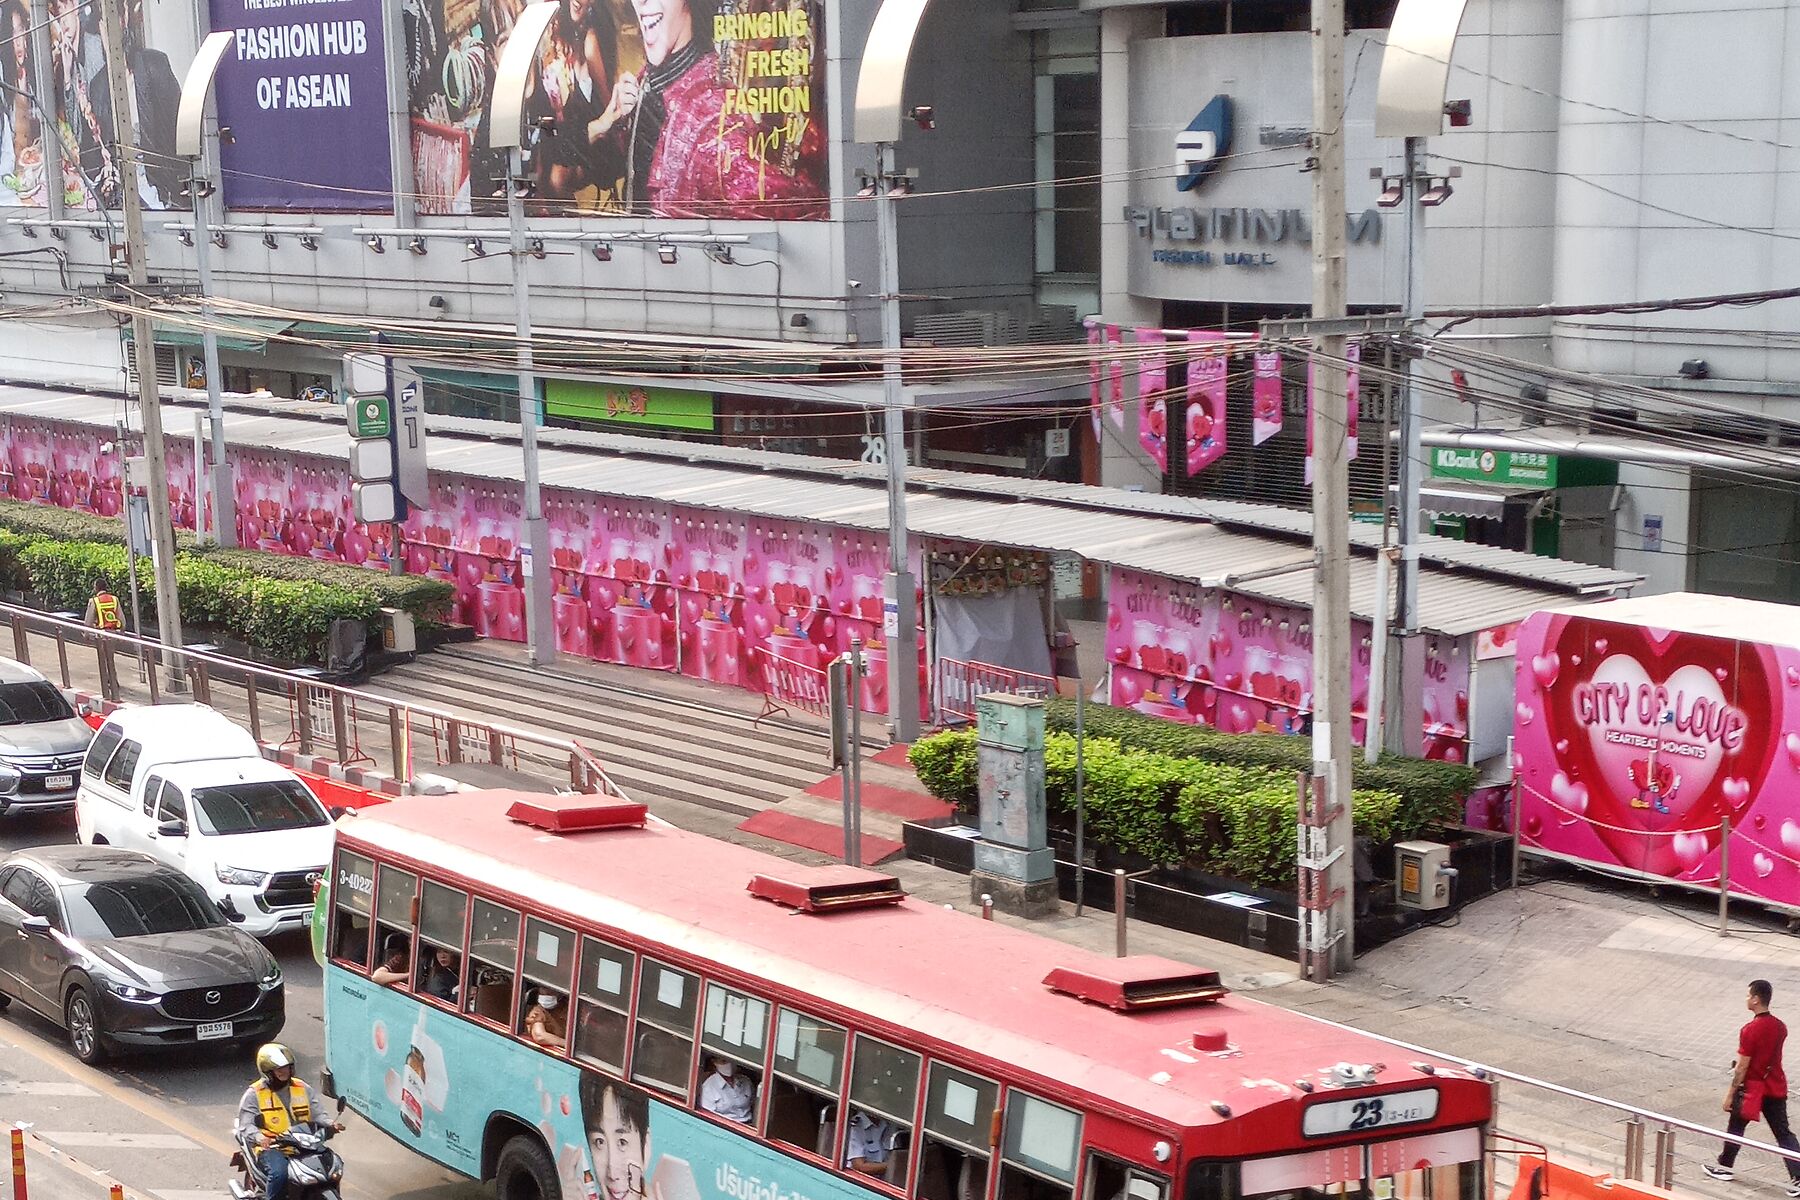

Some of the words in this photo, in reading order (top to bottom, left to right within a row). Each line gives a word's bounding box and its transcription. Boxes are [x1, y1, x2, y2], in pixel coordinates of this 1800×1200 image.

[236, 23, 320, 60] FASHION
[323, 20, 367, 55] HUB
[713, 9, 808, 42] BRINGING
[747, 49, 809, 77] FRESH
[256, 76, 281, 109] OF
[286, 73, 351, 109] ASEAN
[725, 86, 810, 115] FASHION
[404, 416, 418, 448] 1
[1437, 449, 1479, 469] KBank
[1576, 682, 1630, 725] CITY
[1638, 683, 1669, 726] OF
[1676, 690, 1747, 749] LOVE
[1606, 731, 1659, 750] HEARTBEAT
[1660, 740, 1706, 759] MOMENTS
[1349, 1099, 1384, 1129] 23
